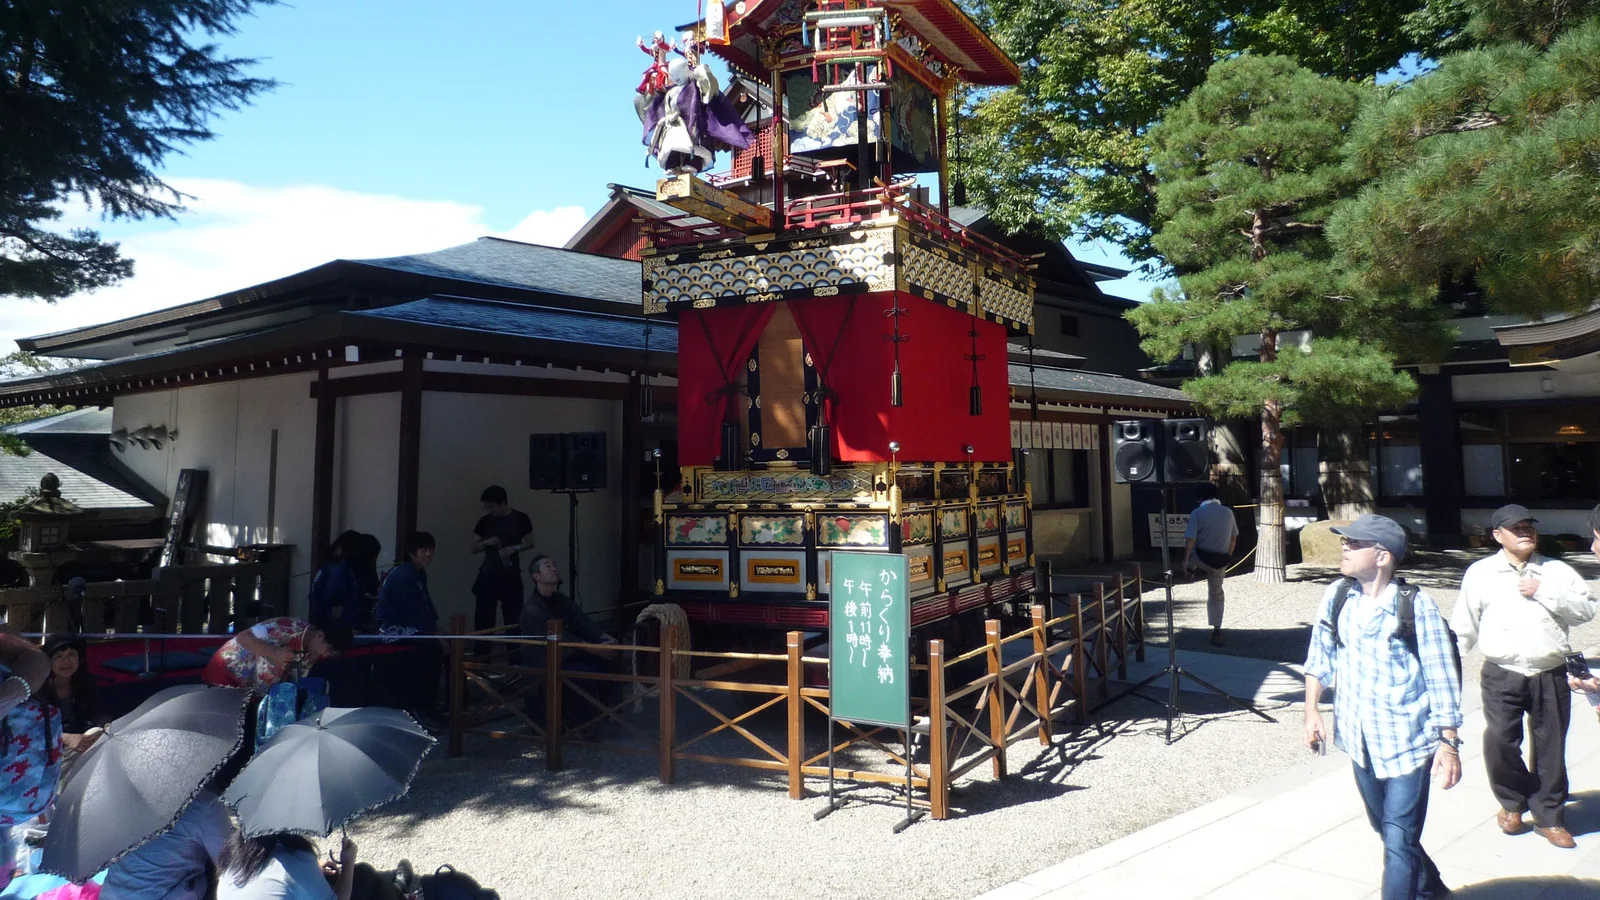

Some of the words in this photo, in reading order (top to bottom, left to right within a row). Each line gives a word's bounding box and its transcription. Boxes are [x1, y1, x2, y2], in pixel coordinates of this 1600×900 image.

[877, 568, 898, 684] からくり奉納
